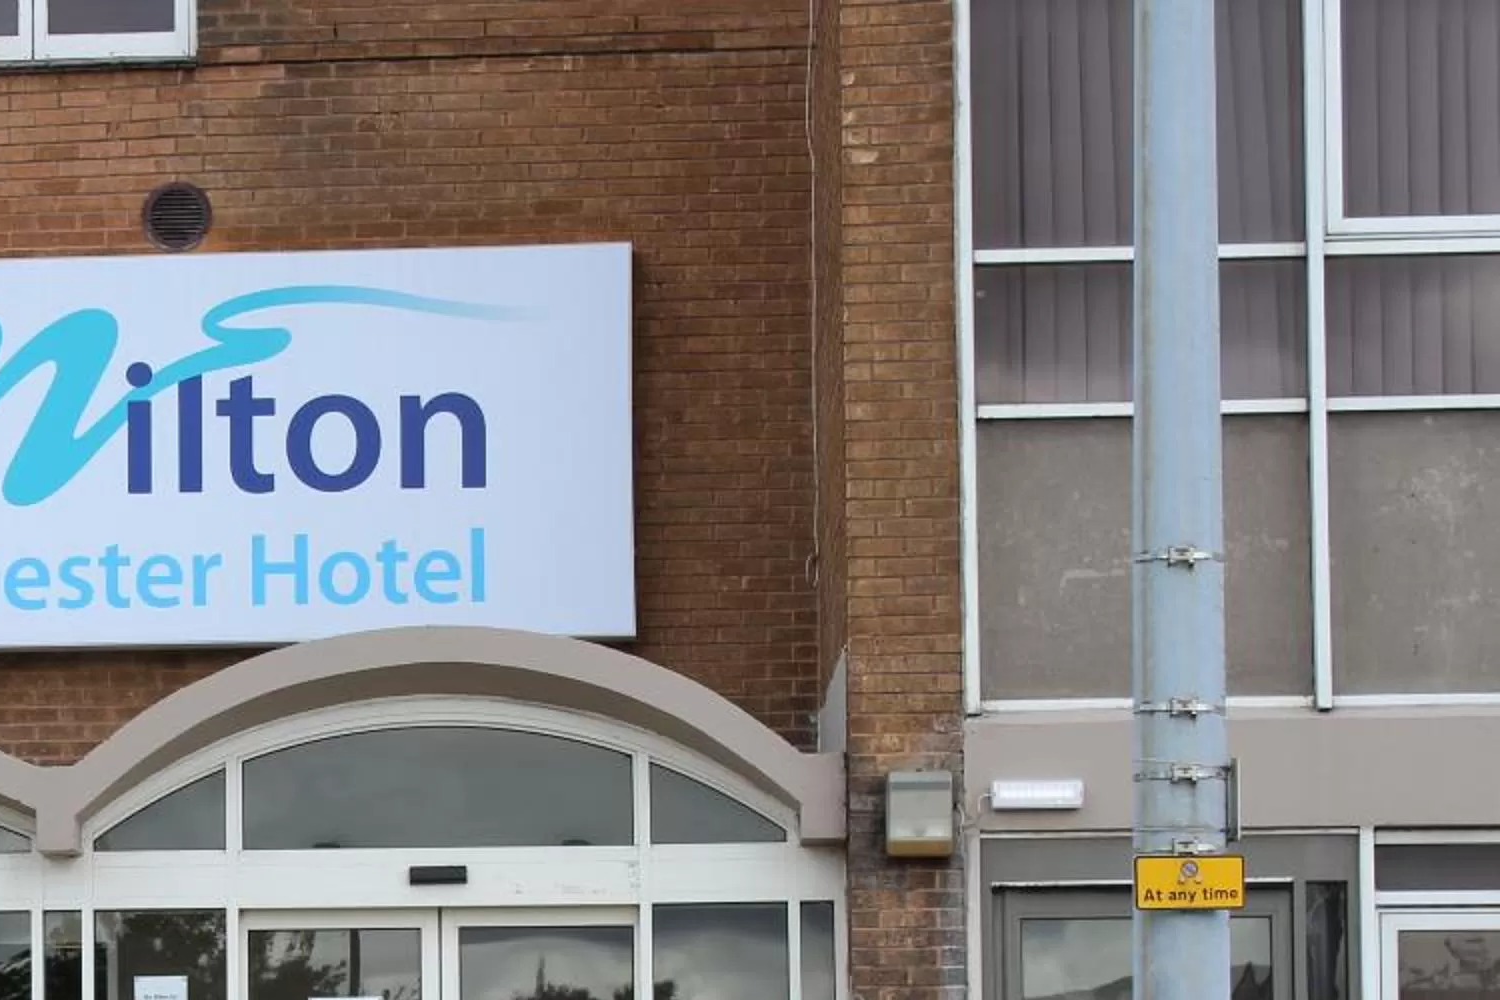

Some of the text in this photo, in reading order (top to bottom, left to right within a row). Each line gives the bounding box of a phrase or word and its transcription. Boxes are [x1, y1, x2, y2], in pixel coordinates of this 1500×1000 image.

[251, 527, 486, 607] Hotel
[1144, 887, 1238, 904] At any time
